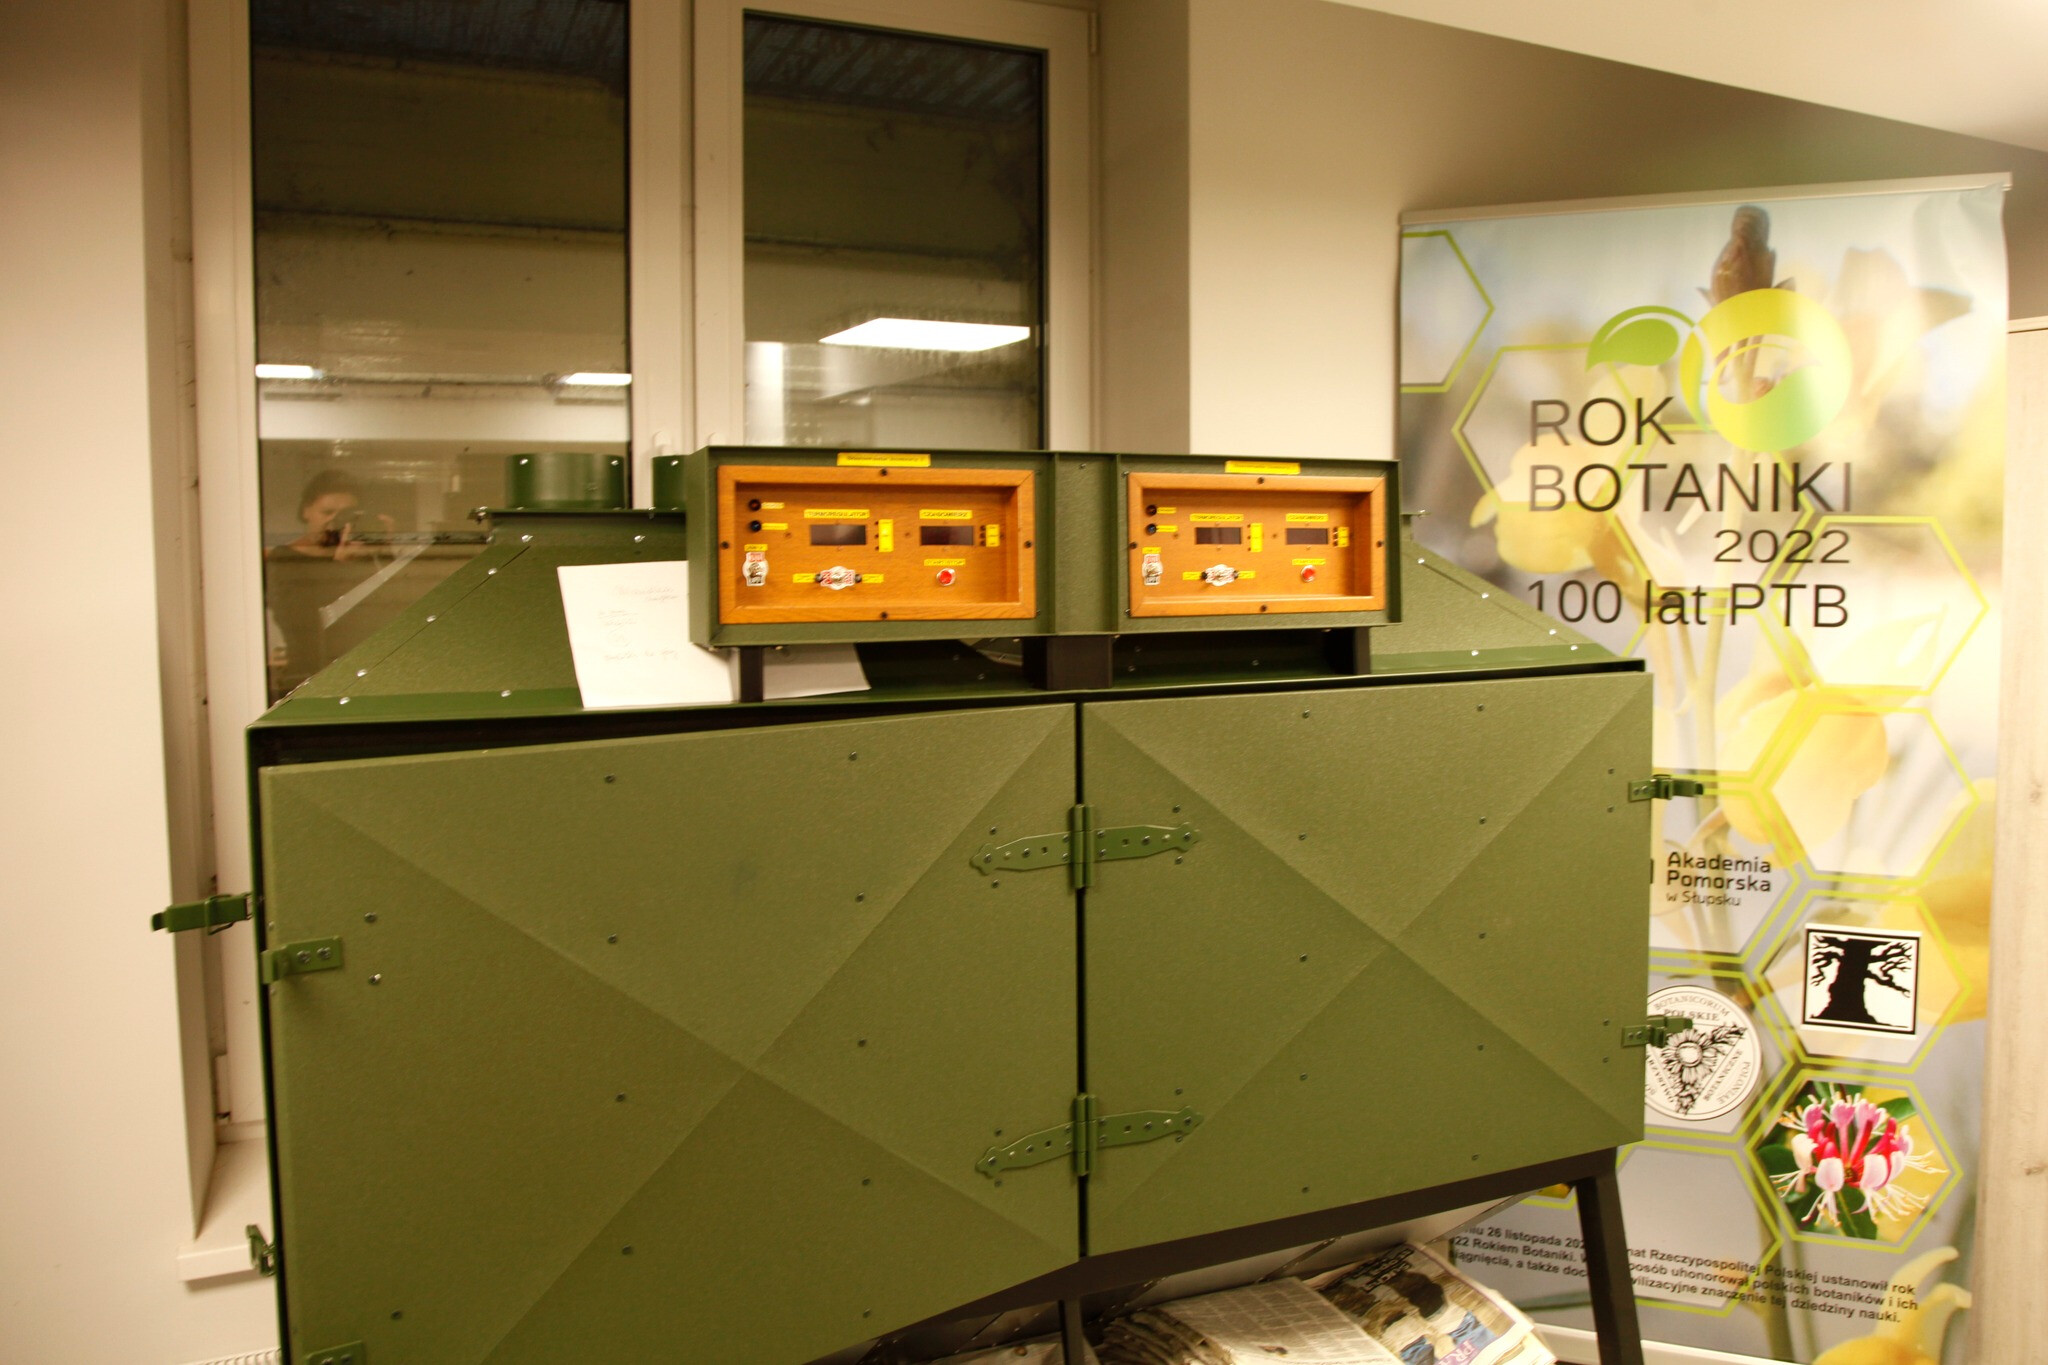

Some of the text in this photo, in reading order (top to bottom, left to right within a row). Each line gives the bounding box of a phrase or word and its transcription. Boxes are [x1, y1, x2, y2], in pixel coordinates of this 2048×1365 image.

[1530, 396, 1677, 447] ROK
[1529, 461, 1853, 513] BOTANIKI
[1713, 529, 1851, 564] 2022
[1527, 579, 1849, 628] 100 lat PTB
[1667, 851, 1771, 873] Akademia
[1666, 869, 1771, 893] Pomorska
[1666, 891, 1741, 908] w Słupsku
[1653, 995, 1731, 1017] BOTANICORUM
[1663, 1009, 1720, 1022] POLSKIE
[1703, 1048, 1744, 1102] BOTANICZNE
[1473, 1237, 1518, 1254] Rokiem
[1522, 1244, 1577, 1263] Botaniki.
[1487, 1226, 1502, 1238] 26
[1504, 1227, 1562, 1246] listopada
[1565, 1238, 1586, 1250] 202
[1516, 1260, 1524, 1269] a
[1527, 1259, 1560, 1274] także
[1627, 1248, 1916, 1296] nat Rzeczypospolitej Polskiej ustanowił rok
[1630, 1263, 1919, 1311] posób uhonorował polskich botaników i ich
[1700, 1285, 1767, 1304] znaczenie
[1770, 1295, 1787, 1309] tej
[1790, 1298, 1856, 1319] dziedziny
[1858, 1307, 1902, 1323] nauki.
